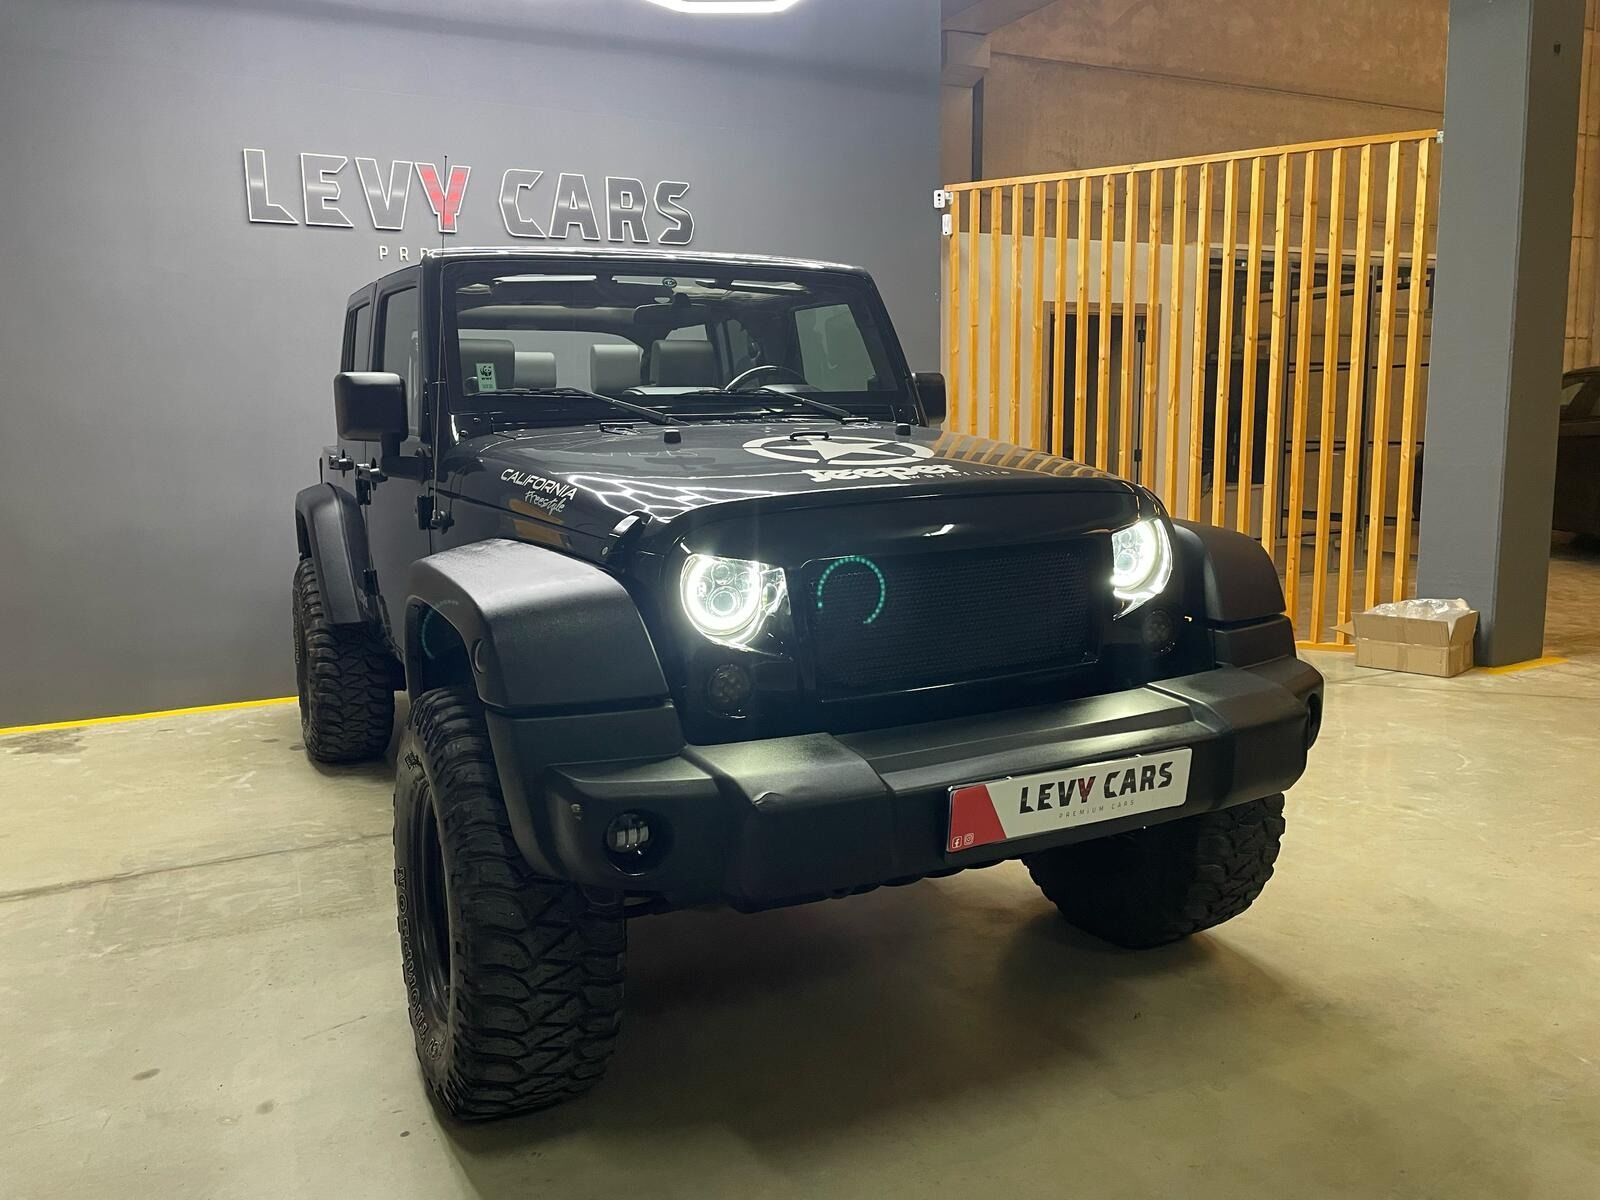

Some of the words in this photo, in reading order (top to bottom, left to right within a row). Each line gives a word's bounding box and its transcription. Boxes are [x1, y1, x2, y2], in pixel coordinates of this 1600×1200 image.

[243, 148, 471, 233] LEVY
[499, 168, 695, 245] CARS
[500, 468, 577, 500] CALIFORNIA
[1019, 775, 1097, 815] LEVY
[1103, 761, 1174, 799] CARS
[1058, 805, 1104, 818] PREMIUM
[1111, 799, 1135, 810] CARS
